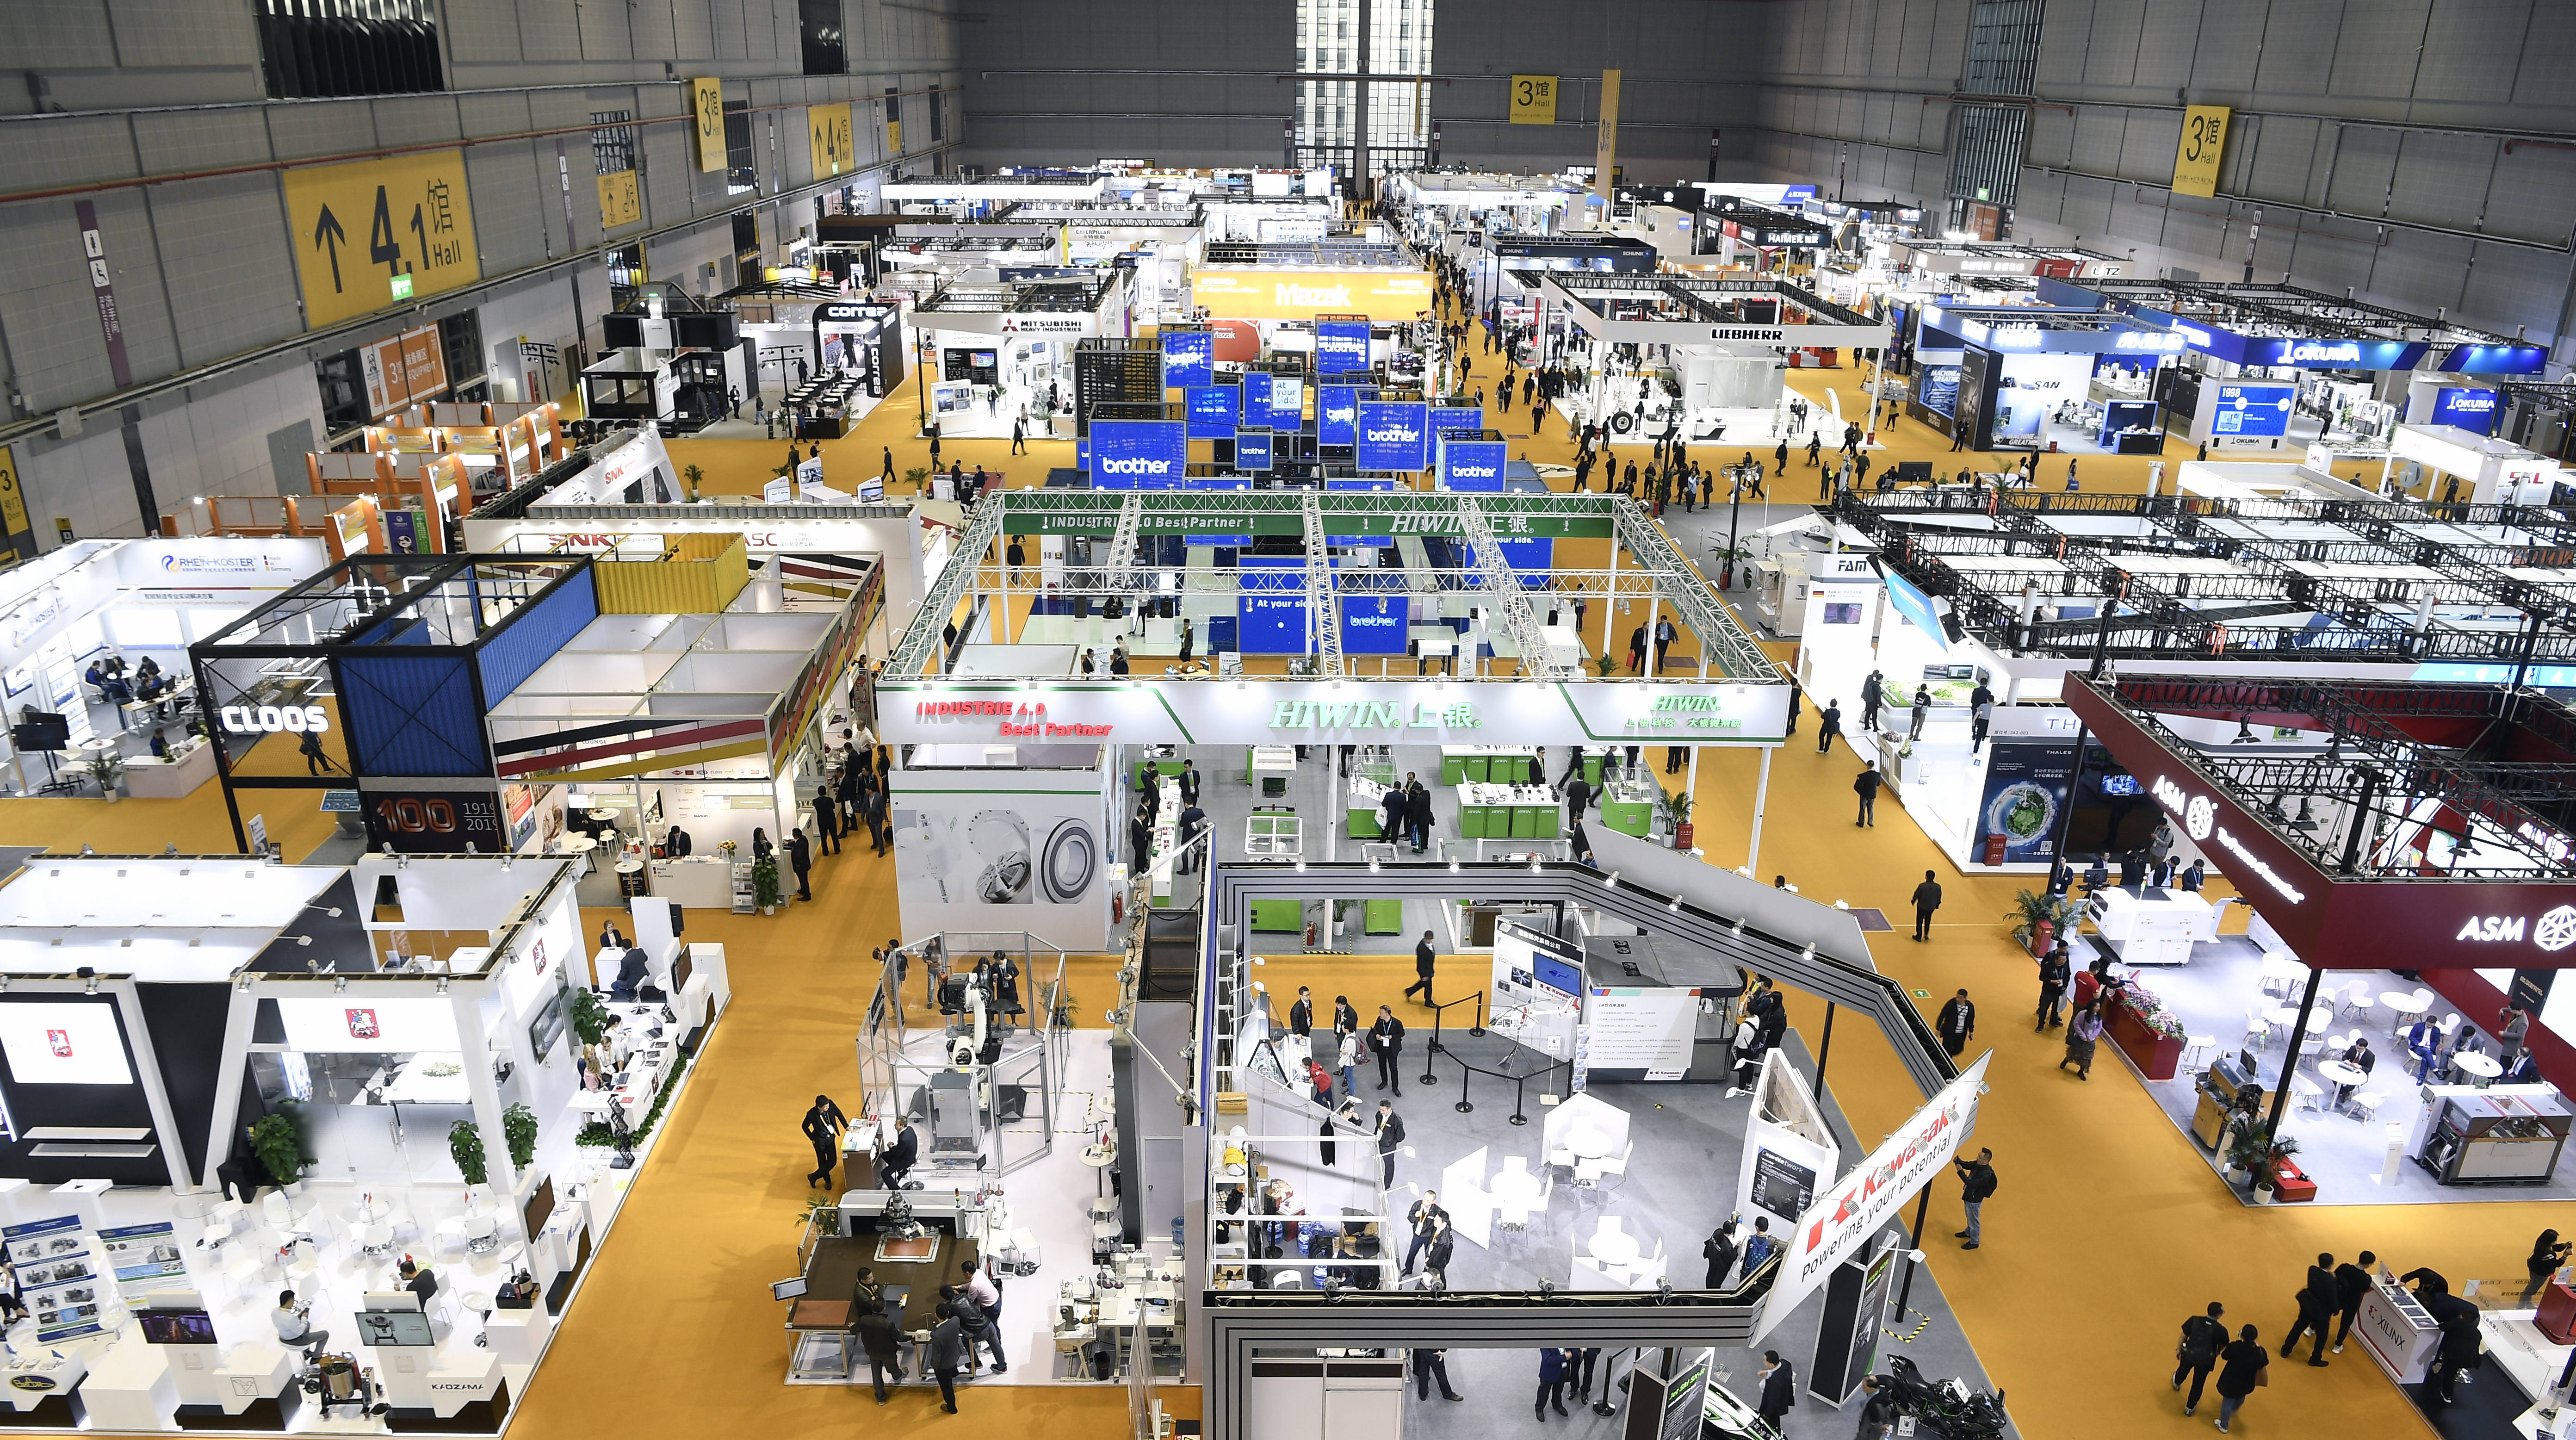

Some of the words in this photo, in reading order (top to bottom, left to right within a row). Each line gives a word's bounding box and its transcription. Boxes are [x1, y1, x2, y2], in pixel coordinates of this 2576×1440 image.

[1518, 81, 1533, 106] 3
[1536, 81, 1549, 96] 馆
[700, 88, 712, 138] 3
[709, 88, 718, 116] 馆
[1600, 119, 1606, 152] 3
[2187, 115, 2204, 161] 3
[2205, 116, 2220, 145] 馆
[2201, 152, 2216, 165] Hall
[371, 185, 430, 277] 4.1
[428, 178, 454, 234] 馆
[1768, 234, 1803, 243] HAIMER
[433, 240, 461, 267] Hall
[1276, 284, 1352, 307] Mazak
[99, 296, 112, 341] Restroom
[828, 307, 888, 317] correa
[1711, 329, 1783, 340] LIEBHERR
[2293, 346, 2361, 361] OKUMA
[390, 362, 398, 384] 3
[408, 361, 436, 379] EQUIPMENT
[871, 348, 881, 394] correa
[2222, 387, 2241, 398] 1998
[2455, 399, 2495, 408] OKUMA
[1368, 429, 1418, 442] brother
[1102, 457, 1171, 474] brother
[1452, 466, 1496, 478] brother
[1, 470, 12, 491] 3
[605, 466, 624, 485] SNK
[2508, 472, 2544, 484] SL
[1052, 516, 1118, 528] INDUSTRI
[1155, 516, 1185, 528] Best
[1190, 516, 1244, 528] Partner
[1838, 560, 1867, 572] FAM
[1270, 601, 1292, 609] your
[1350, 615, 1398, 627] brother
[918, 701, 1013, 715] INDUSTRIE
[1017, 701, 1045, 715] 4.0
[1651, 695, 1721, 711] HIWIN
[222, 705, 329, 732] CLOOS
[1626, 718, 1675, 728] 上银科技
[1000, 722, 1040, 737] Best
[1044, 722, 1114, 737] Partner
[2152, 775, 2186, 816] ASM
[377, 799, 456, 833] 100
[464, 803, 495, 815] 1919
[467, 819, 497, 831] 2019
[2456, 915, 2526, 942] ASM
[1862, 1098, 1957, 1203] Kawasaki
[1801, 1216, 1864, 1283] Powering
[1868, 1190, 1896, 1224] your
[1898, 1130, 1952, 1198] potential
[1867, 1270, 1879, 1284] Ninja
[1879, 1259, 1889, 1272] H2R
[2377, 1315, 2405, 1351] XILINX
[1669, 1389, 1679, 1400] Jet
[1679, 1379, 1690, 1392] Ski
[1690, 1369, 1706, 1384] SX-R
